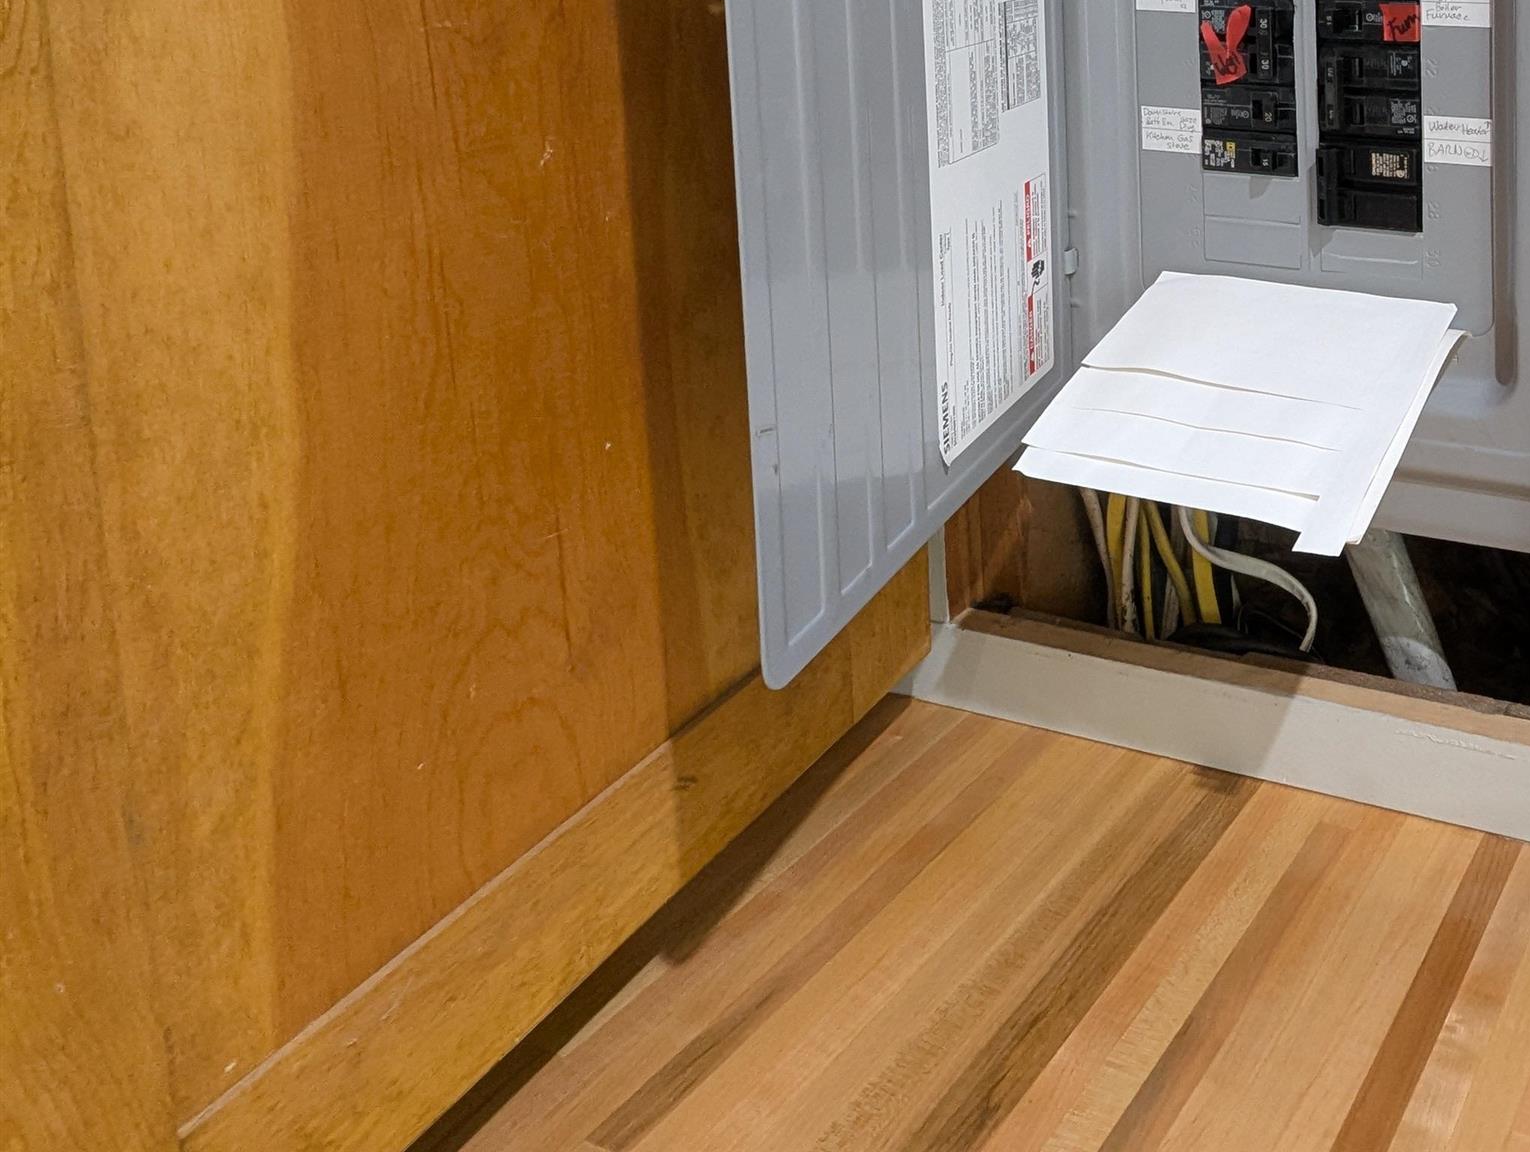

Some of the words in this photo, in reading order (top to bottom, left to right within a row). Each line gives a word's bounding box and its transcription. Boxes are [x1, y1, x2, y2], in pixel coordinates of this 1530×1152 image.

[1260, 18, 1268, 29] 30
[1261, 59, 1270, 70] 30
[1264, 112, 1273, 123] 20
[1428, 120, 1460, 132] Water
[940, 381, 950, 455] SIEMENS
